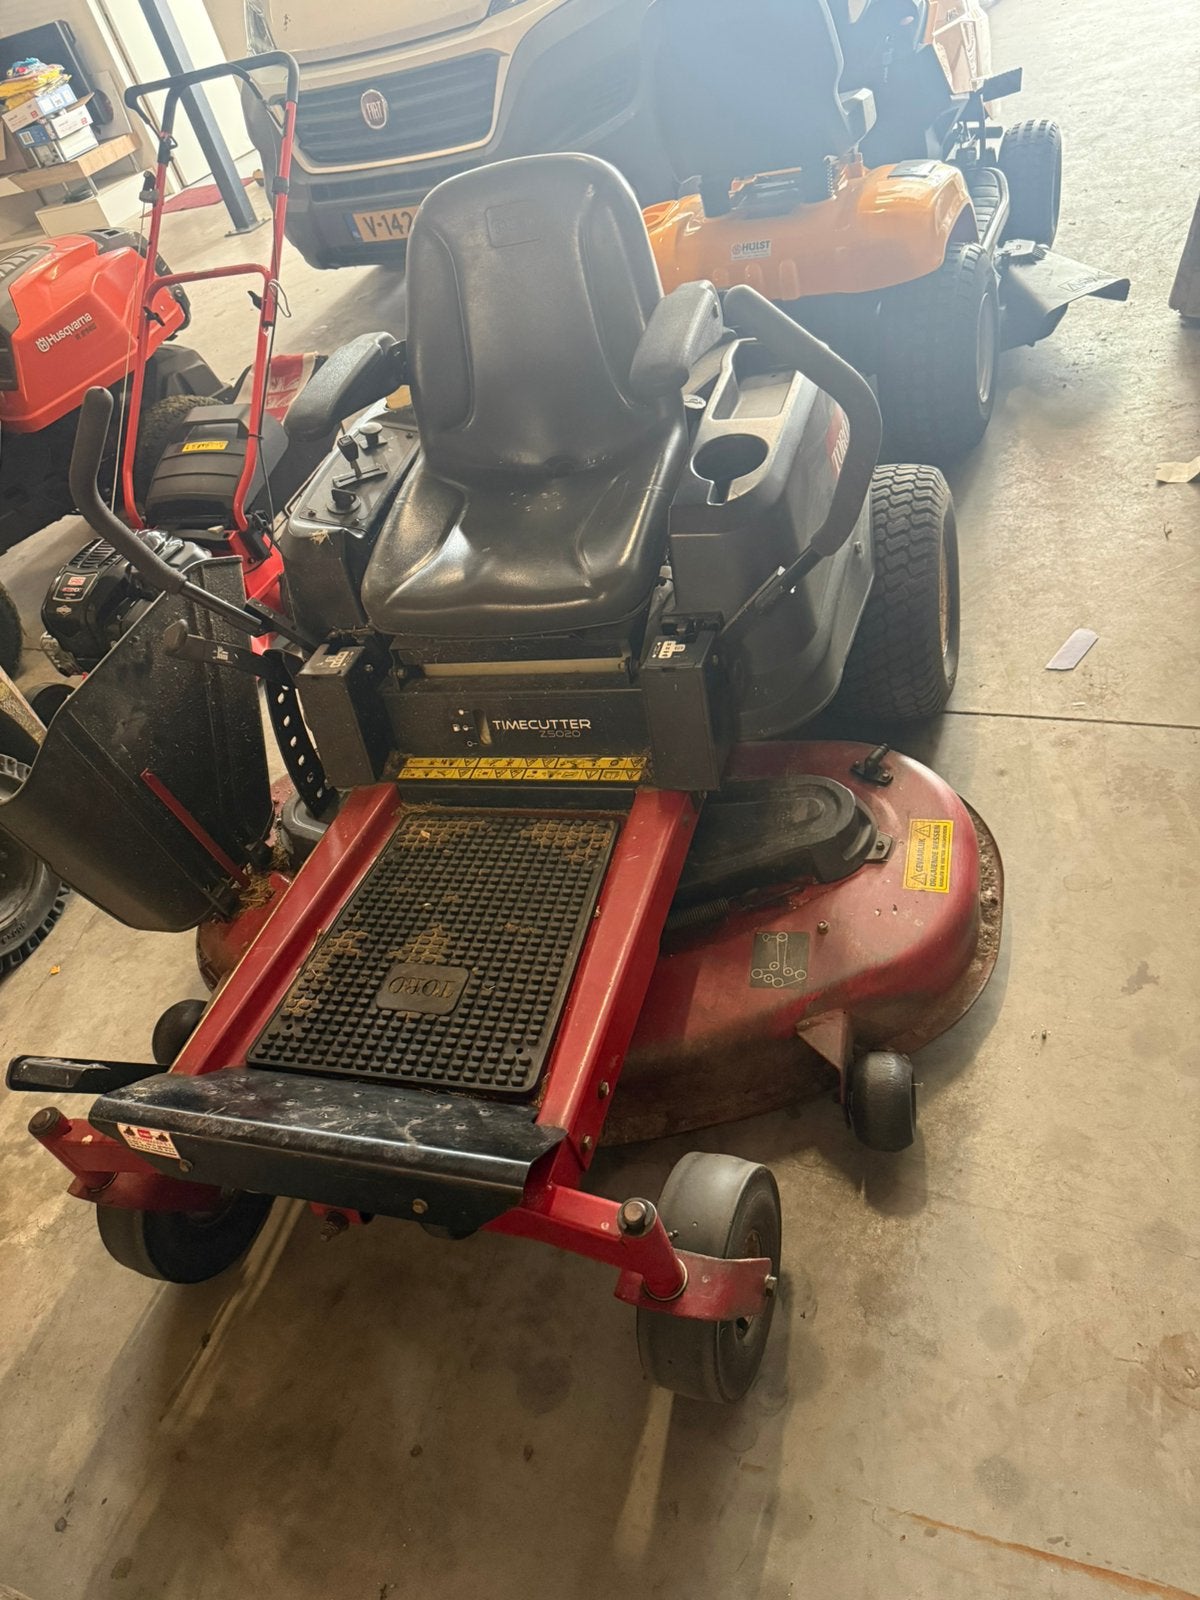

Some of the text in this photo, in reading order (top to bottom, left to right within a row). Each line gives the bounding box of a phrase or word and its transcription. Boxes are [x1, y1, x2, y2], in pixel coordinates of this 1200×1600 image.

[366, 102, 382, 120] FIAT
[46, 312, 93, 345] Husqvarna
[492, 719, 592, 730] TIMECUTTER
[540, 730, 581, 738] Z5020
[389, 977, 456, 998] TORO
